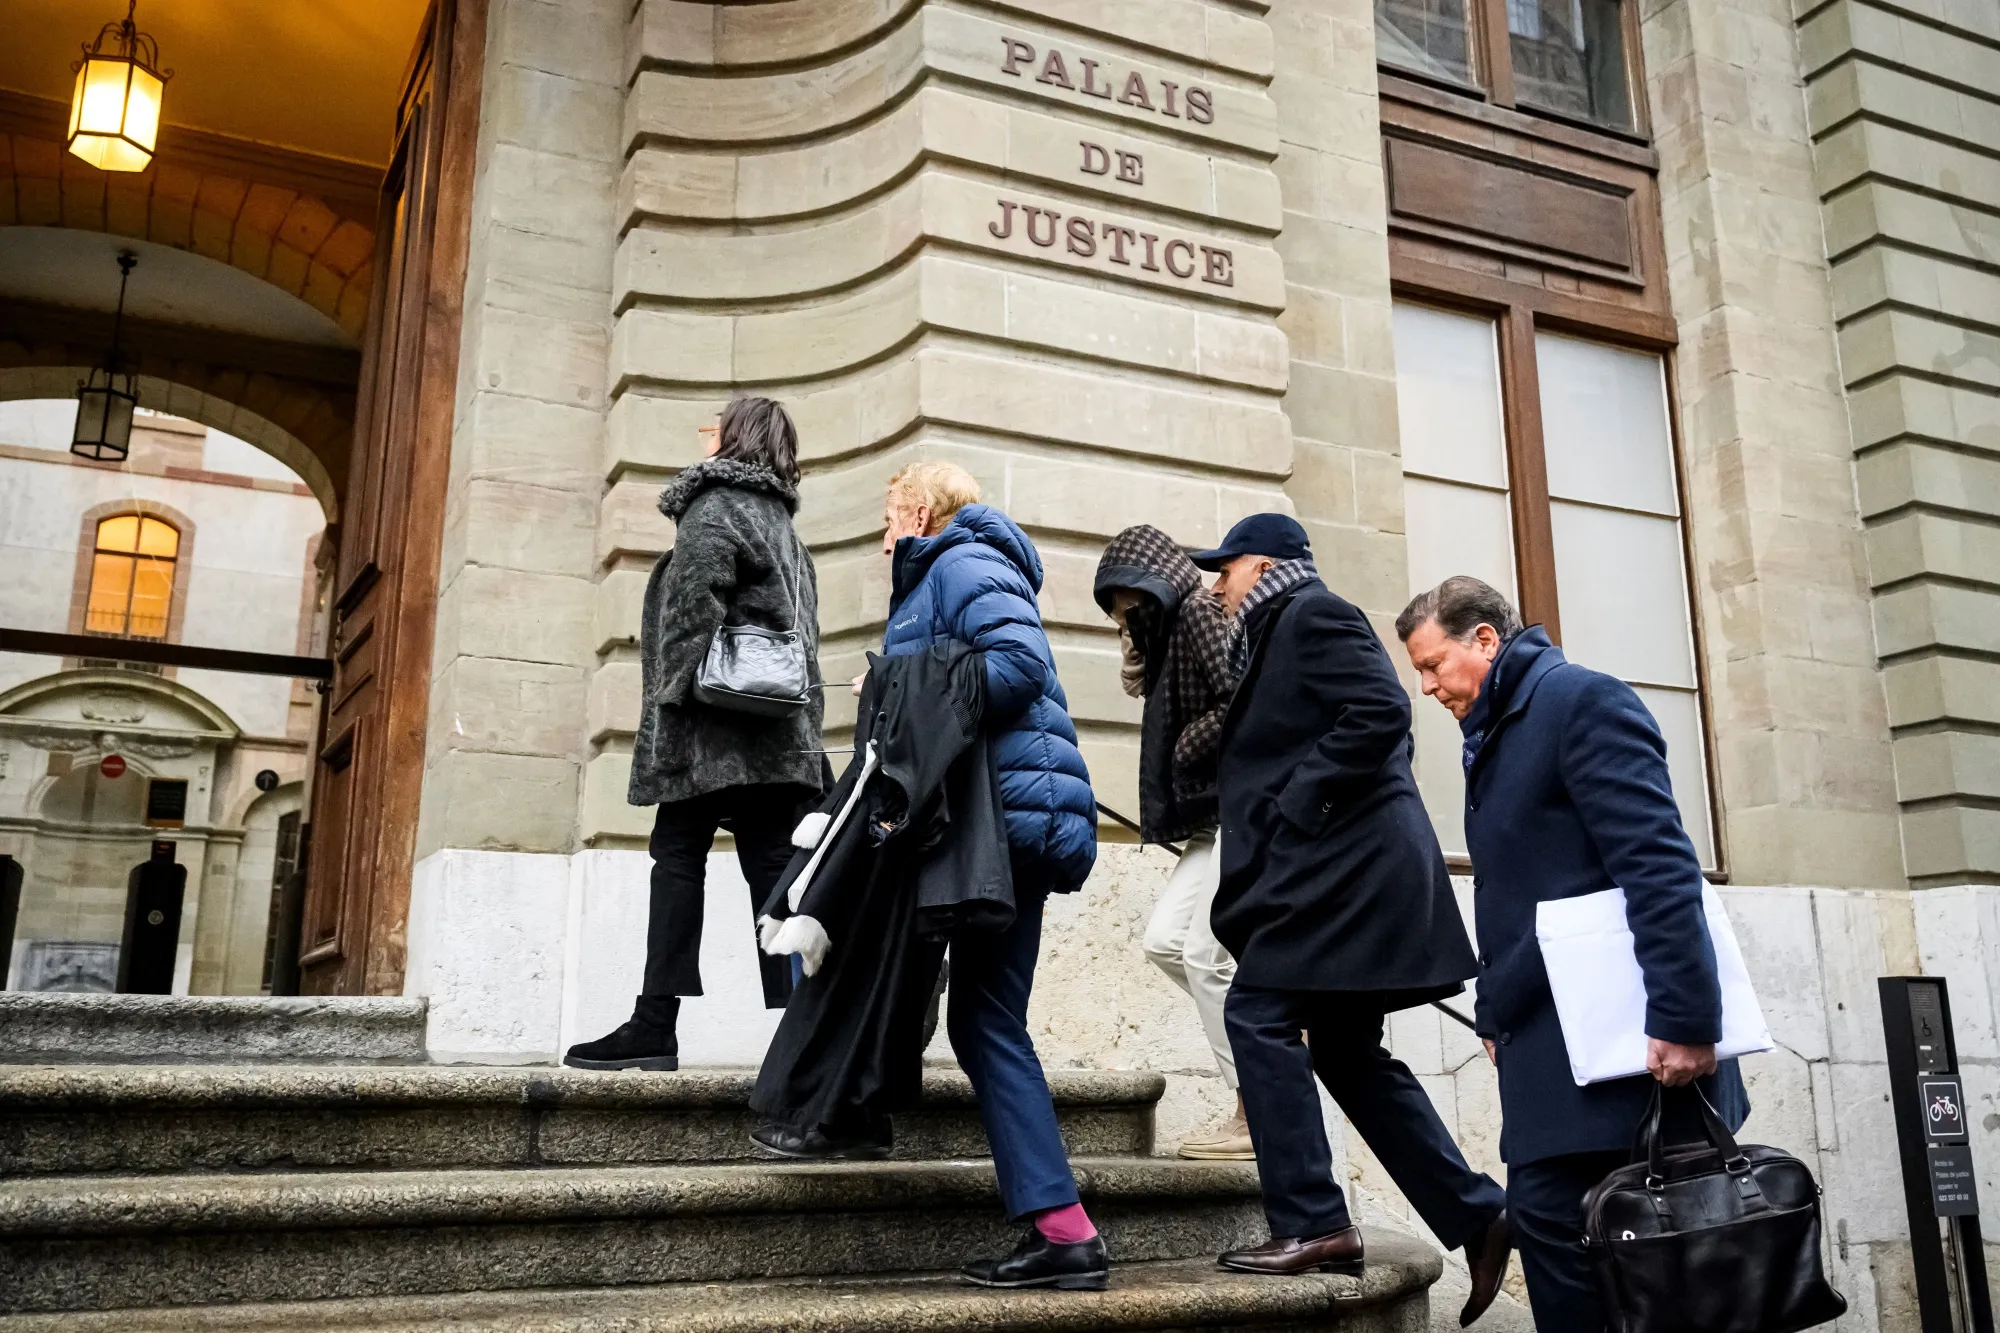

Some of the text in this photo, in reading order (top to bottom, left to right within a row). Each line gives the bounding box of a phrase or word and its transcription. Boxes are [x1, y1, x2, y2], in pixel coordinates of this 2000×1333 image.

[1001, 36, 1215, 124] PALAIS
[1079, 140, 1144, 185] DE
[988, 199, 1234, 287] JUSTICE
